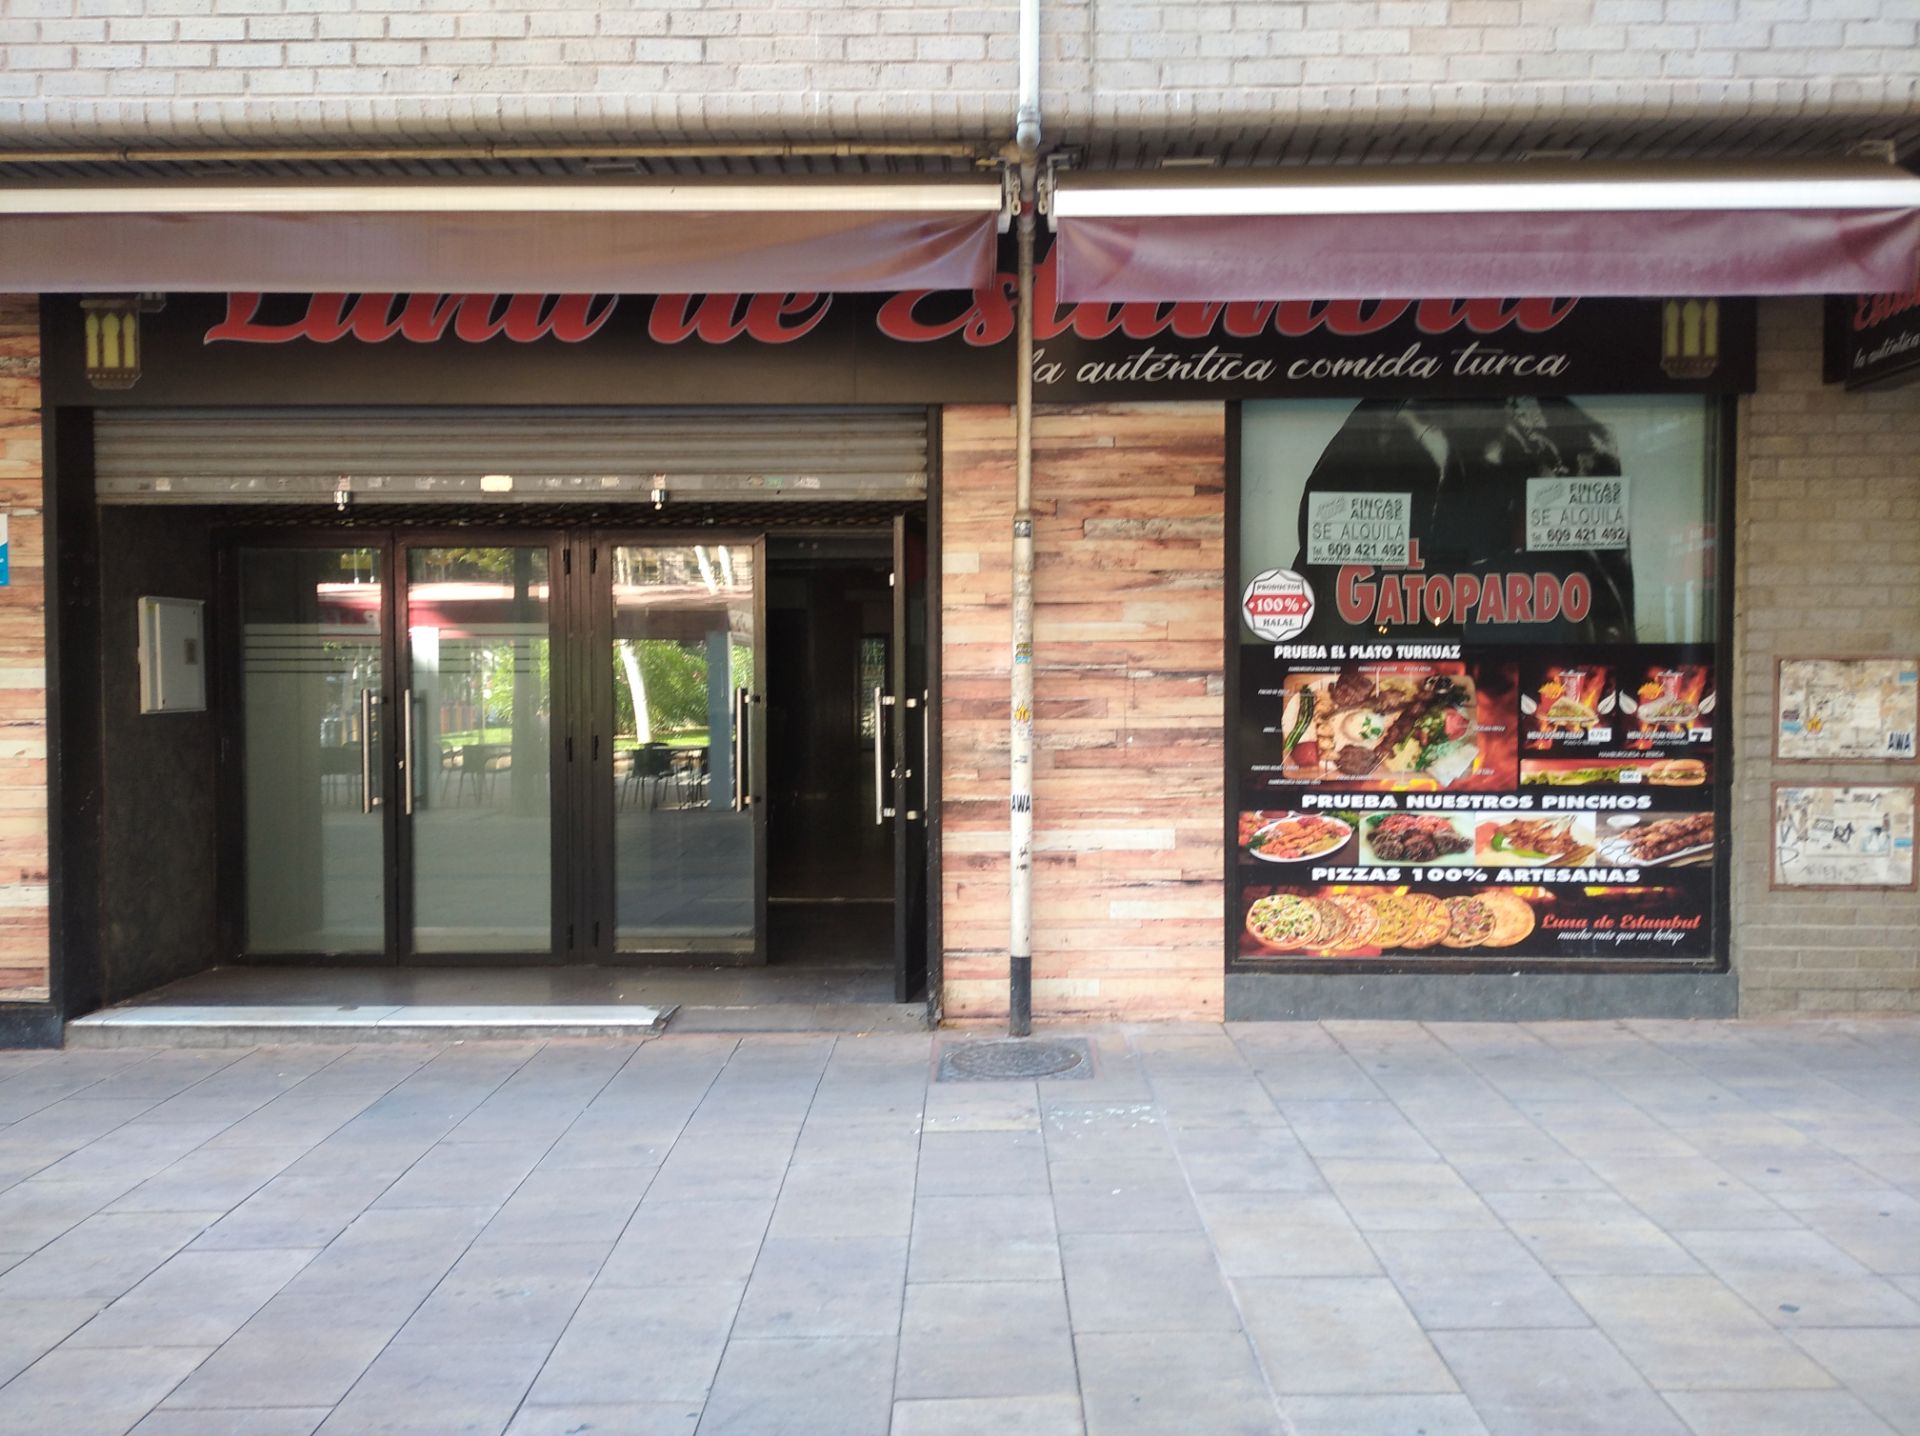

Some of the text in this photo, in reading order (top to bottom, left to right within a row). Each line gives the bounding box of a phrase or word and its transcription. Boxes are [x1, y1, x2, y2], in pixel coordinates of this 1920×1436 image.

[1287, 342, 1444, 381] comida
[1451, 344, 1571, 379] turca
[1530, 506, 1625, 526] SE ALQUILA
[1312, 521, 1405, 541] SE ALQUILA
[1546, 528, 1572, 542] 609
[1574, 527, 1597, 541] 421
[1601, 527, 1626, 541] 492
[1327, 543, 1351, 557] 609
[1354, 543, 1377, 557] 421
[1381, 543, 1405, 557] 492
[1335, 564, 1592, 625] GATOPARDO
[1256, 597, 1300, 613] 100%
[1263, 618, 1295, 627] HALAL
[1273, 644, 1462, 660] PRUEBA EL PLATO TURKUAZ
[1301, 794, 1653, 810] PRUEBA NUESTROS PINCHOS
[1312, 867, 1641, 883] PIZZAS 100% ARTESANAS
[1541, 913, 1702, 930] Luna de Estambul
[1615, 931, 1636, 947] que
